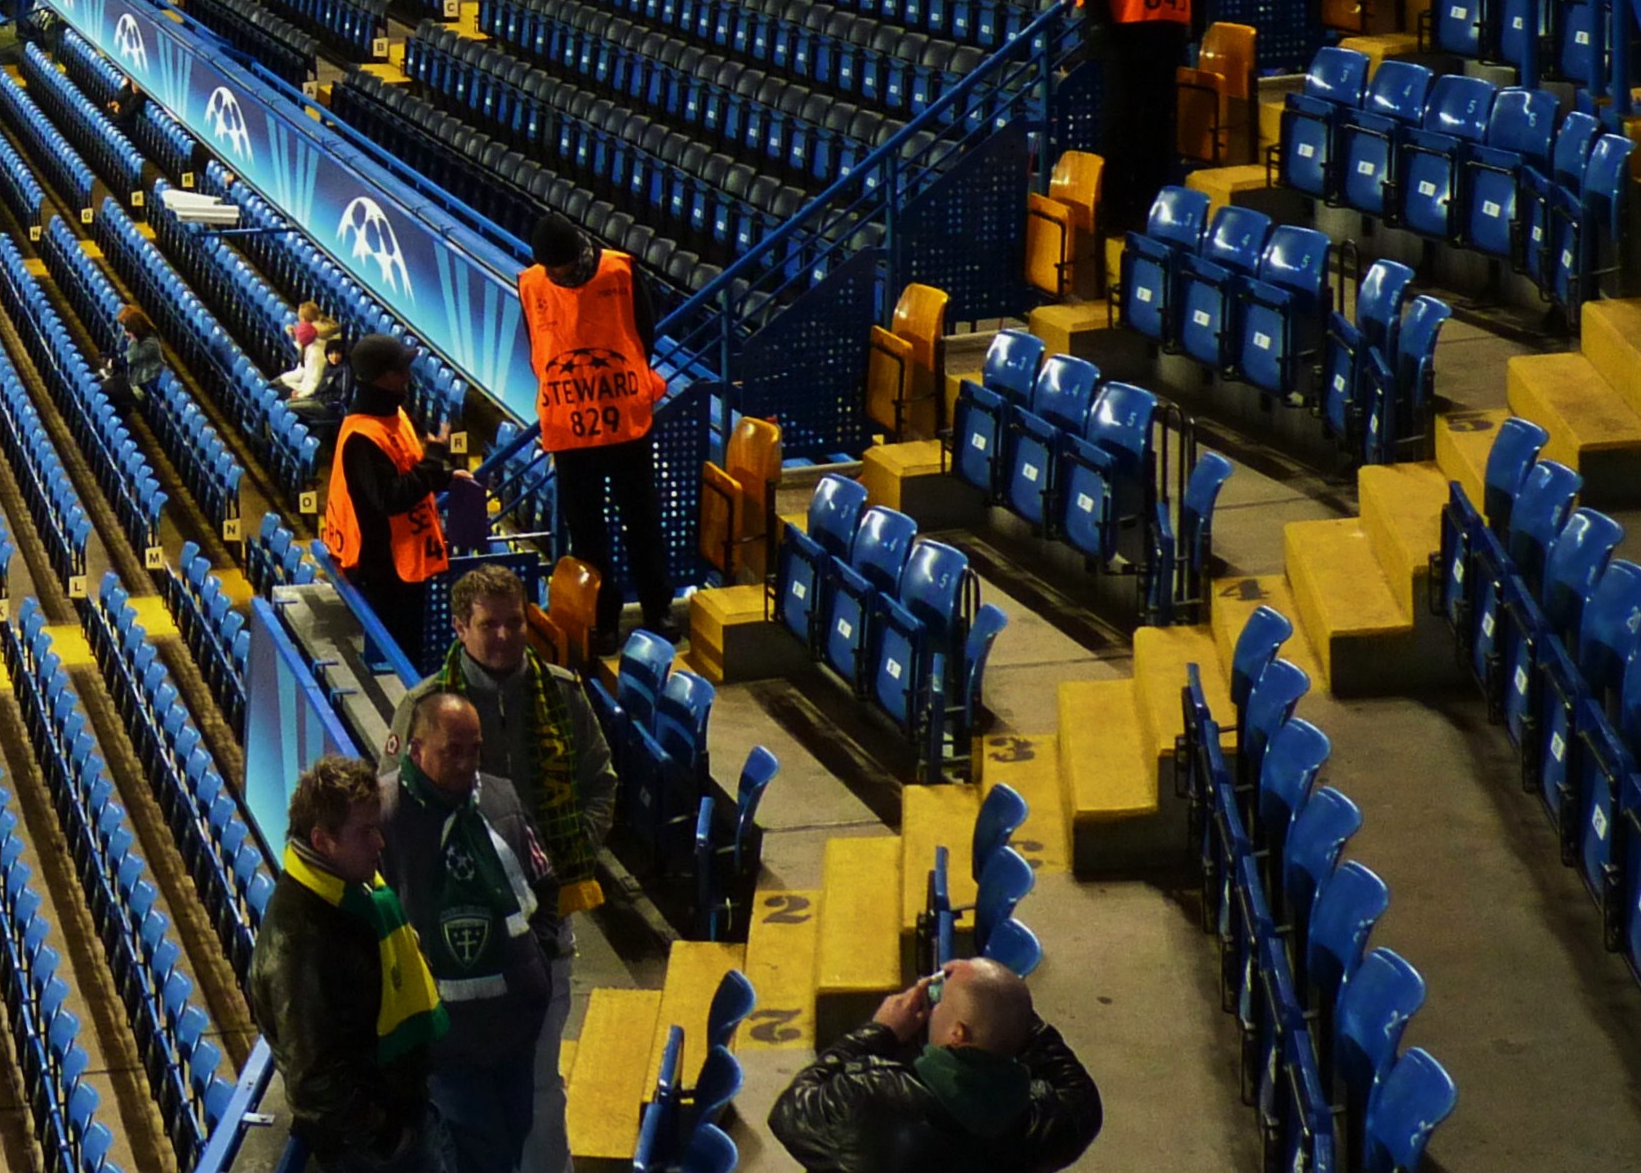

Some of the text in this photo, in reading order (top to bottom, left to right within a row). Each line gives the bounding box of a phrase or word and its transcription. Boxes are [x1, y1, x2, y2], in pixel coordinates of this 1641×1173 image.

[541, 371, 639, 408] STEWARD
[570, 407, 620, 439] 829
[988, 735, 1038, 763] 3
[763, 894, 813, 925] 2
[748, 1009, 804, 1044] 2
